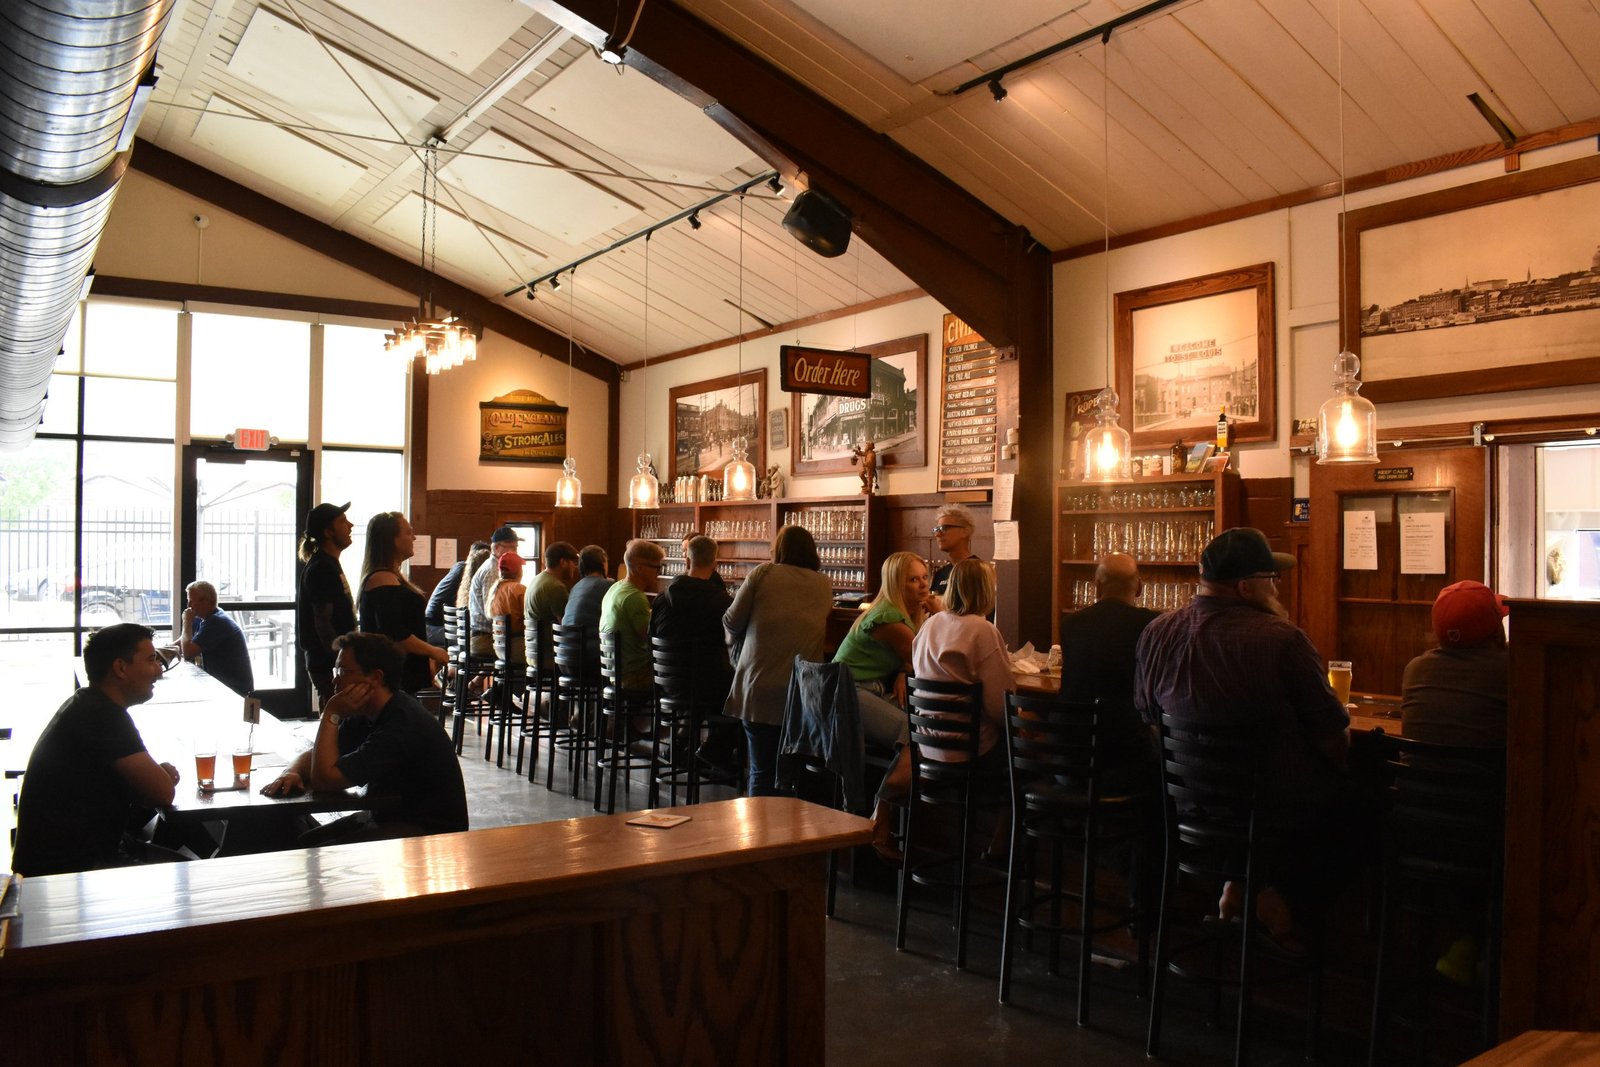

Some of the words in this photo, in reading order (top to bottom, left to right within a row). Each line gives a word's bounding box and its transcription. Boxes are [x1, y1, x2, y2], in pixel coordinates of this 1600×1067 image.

[794, 357, 831, 384] Order
[830, 359, 860, 386] Here
[839, 399, 866, 414] DRUGS
[241, 430, 265, 449] EXIT
